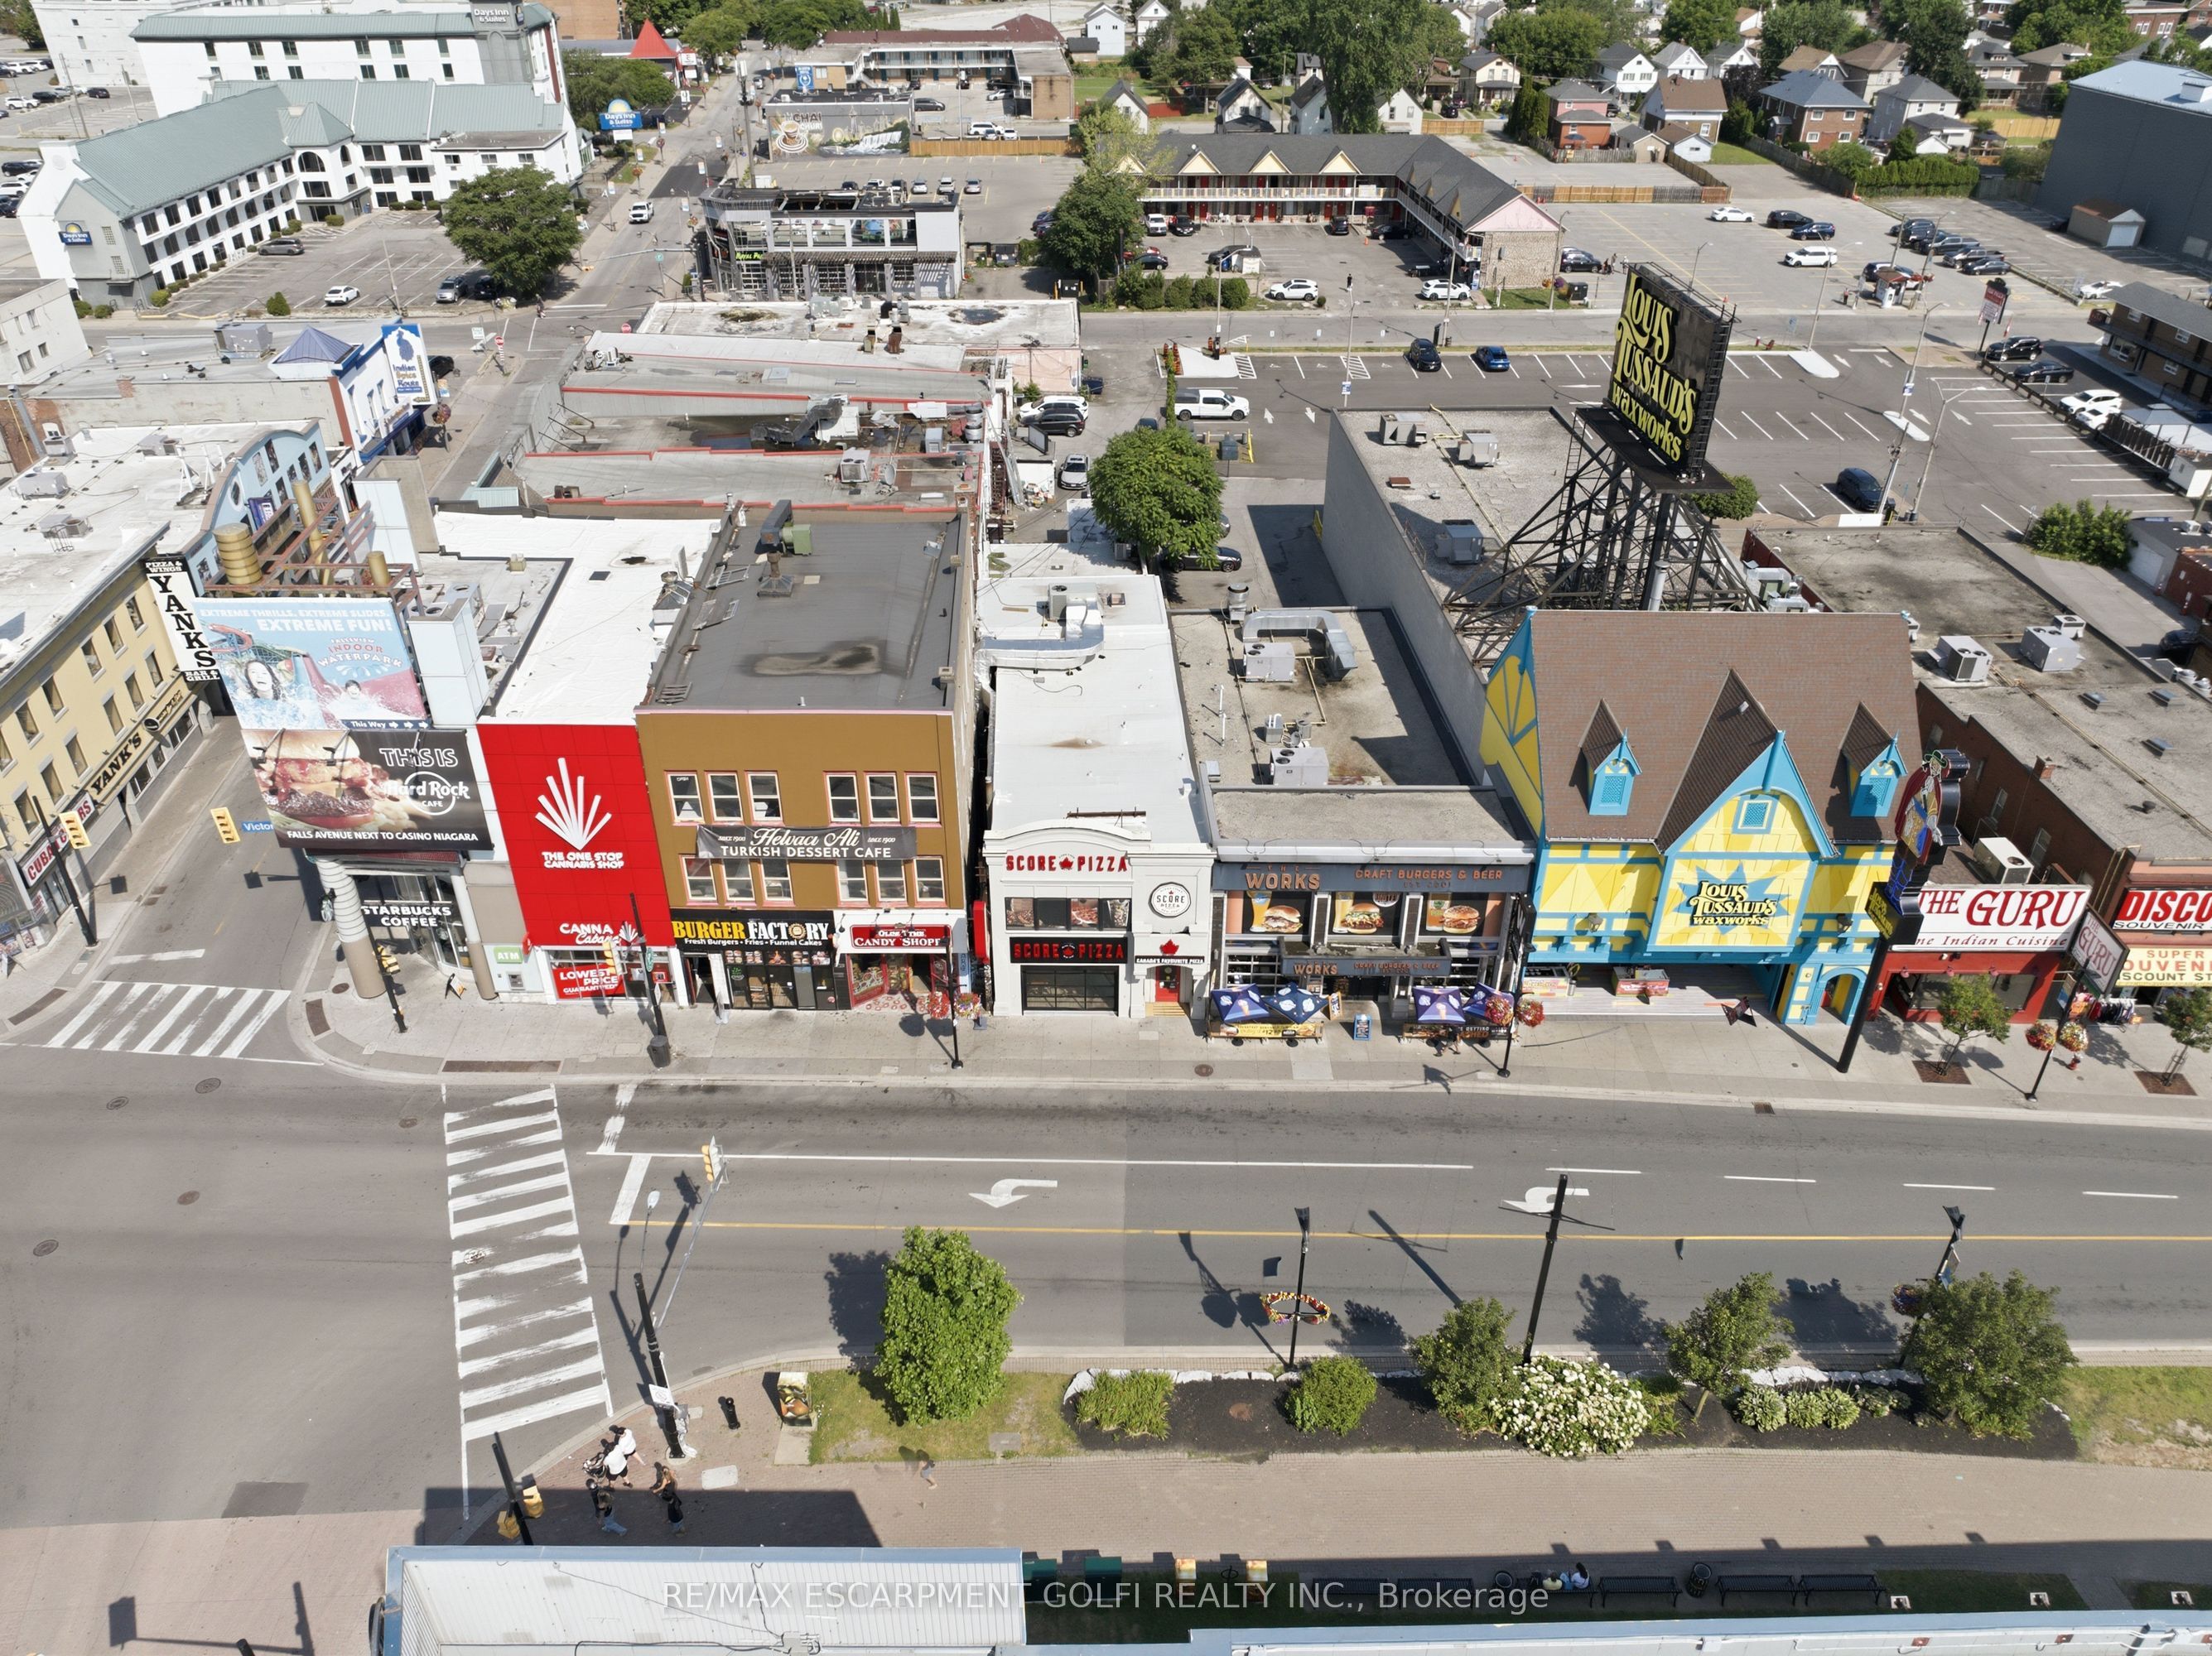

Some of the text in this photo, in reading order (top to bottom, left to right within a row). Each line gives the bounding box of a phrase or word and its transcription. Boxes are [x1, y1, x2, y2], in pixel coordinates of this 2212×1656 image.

[474, 8, 509, 17] Days Inn
[793, 113, 822, 123] CHAI
[1623, 272, 1674, 364] LOUIS
[1614, 316, 1697, 435] TUSSAUD'S
[150, 575, 216, 668] YANKS
[257, 619, 393, 632] EXTREME FUN!
[328, 644, 384, 653] INDOOR
[317, 652, 403, 667] WATERPARK
[371, 721, 387, 729] Way
[90, 733, 142, 795] YANK'S
[378, 748, 459, 768] THIS IS
[428, 781, 471, 800] Rock
[316, 831, 353, 840] AVENUE
[354, 831, 379, 840] NEXT
[395, 832, 432, 840] CASINO
[433, 833, 479, 841] NIAGARA
[823, 827, 861, 847] Ali
[542, 851, 624, 861] THE ONE STOP
[720, 845, 892, 858] TURKISH DESSERT CAFE
[543, 859, 624, 869] CANNABIS SHOP
[1005, 854, 1128, 872] SCORE PIZZA
[1355, 869, 1503, 880] CRAFT BURGERS & BEER
[1246, 873, 1320, 890] WORKS
[1698, 881, 1749, 903] LOUIS
[1156, 895, 1185, 903] SCORE
[360, 905, 452, 916] STARBUCKS
[1689, 896, 1778, 917] TUSSAUD'S
[1918, 889, 2086, 930] THE GURU
[380, 917, 439, 927] COFFEE
[1692, 915, 1769, 926] waxworks
[2086, 915, 2100, 935] THE
[559, 922, 614, 935] CANNA
[672, 921, 830, 940] BURGER FACTORY
[707, 938, 740, 946] Burgers
[854, 937, 942, 946] CANDY SHOPP
[1941, 934, 1998, 946] Indian
[2006, 935, 2068, 946] Cuisine
[497, 951, 520, 960] ATM
[1013, 943, 1125, 959] SCORE PIZZA
[2078, 926, 2117, 977] GURU
[2147, 950, 2205, 959] SUPER
[1294, 965, 1338, 975] WORKS
[2123, 960, 2212, 972] OUVEN
[559, 968, 611, 980] LOWEST
[2123, 972, 2186, 981] SCOUNT
[583, 975, 619, 986] PRICE
